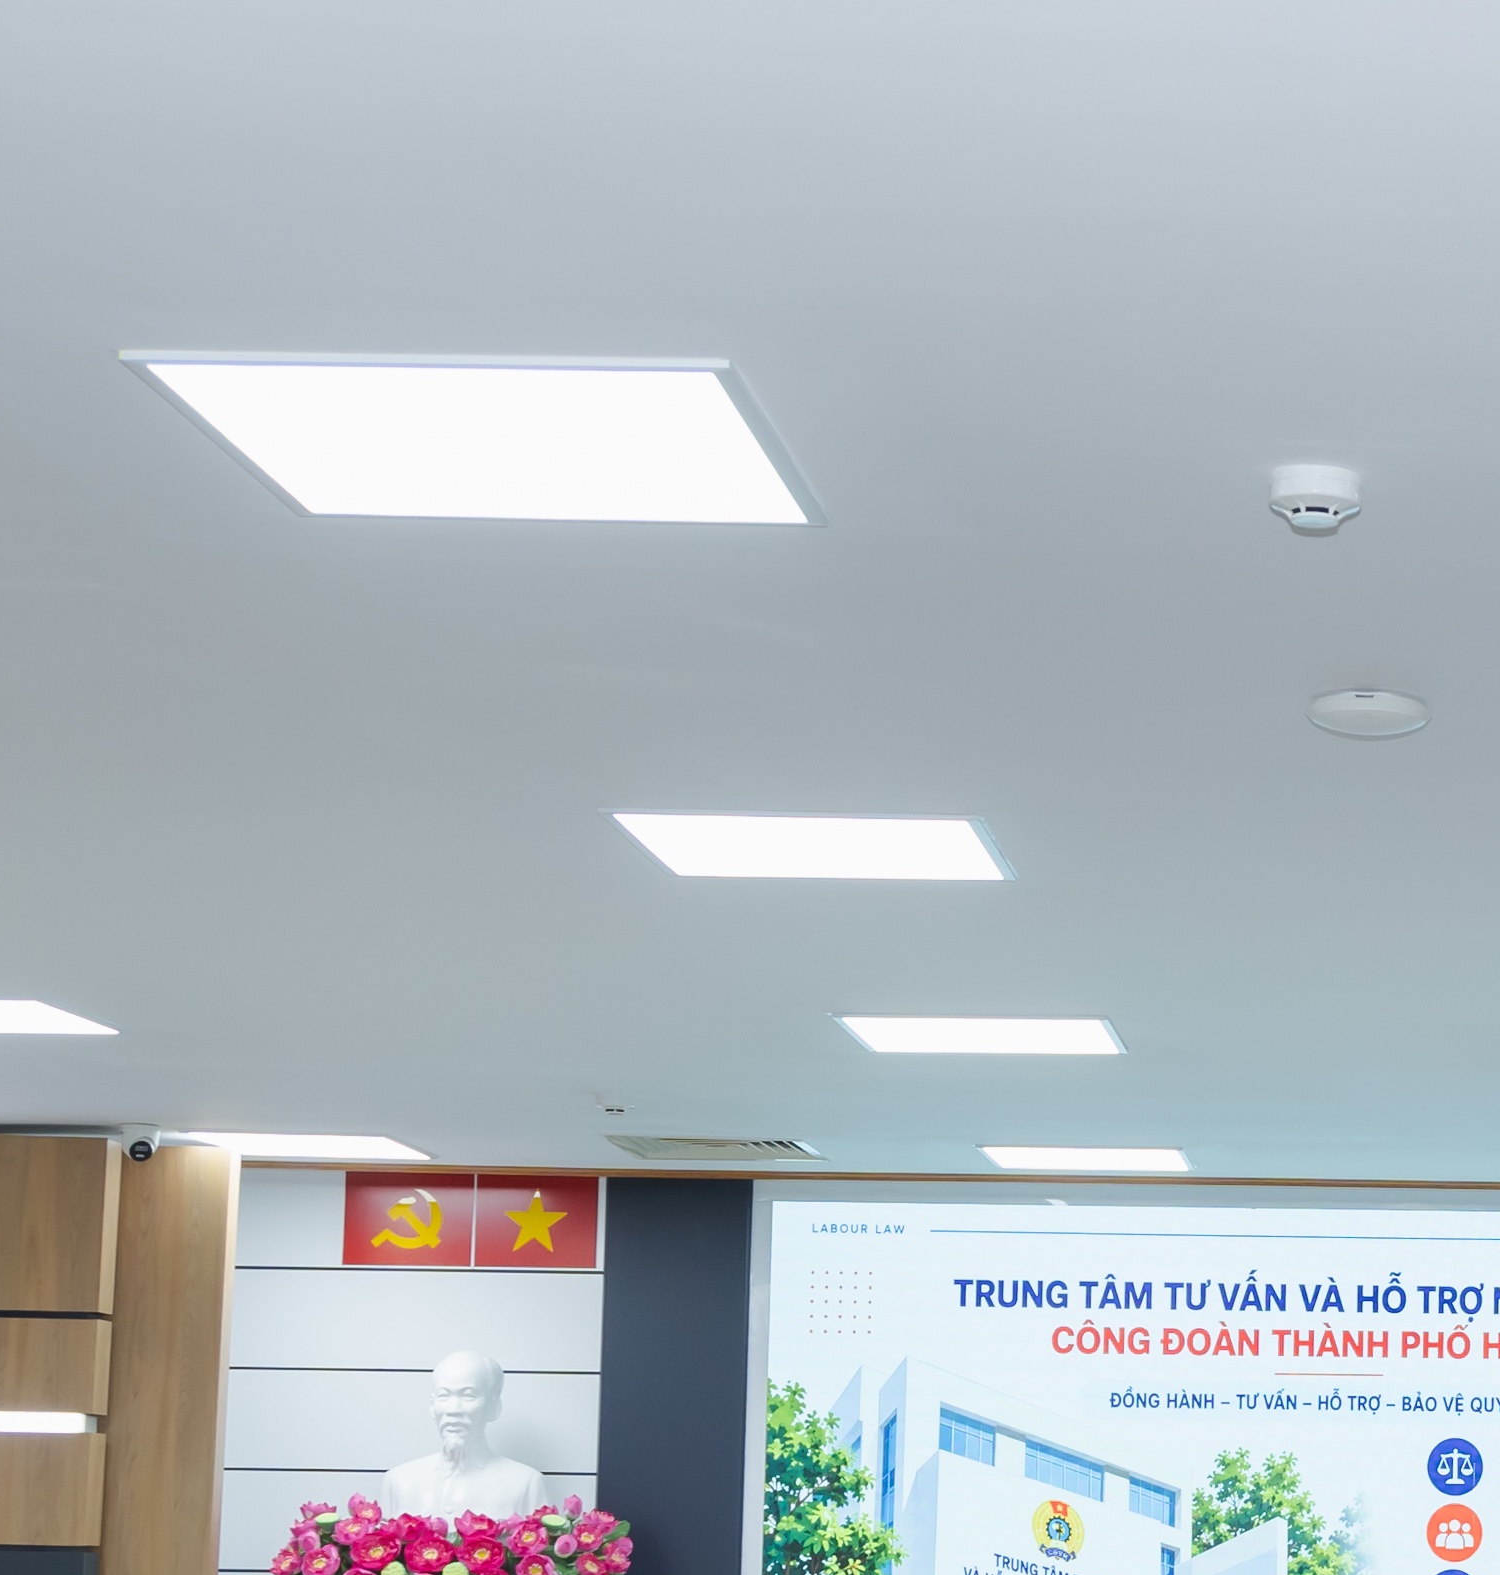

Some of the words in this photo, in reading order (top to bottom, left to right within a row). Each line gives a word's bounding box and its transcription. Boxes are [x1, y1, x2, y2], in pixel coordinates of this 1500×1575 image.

[812, 1223, 868, 1234] LABOUR
[875, 1224, 905, 1234] LAW
[954, 1279, 1068, 1308] TRUNG
[1079, 1274, 1153, 1310] TÂM
[1164, 1280, 1211, 1310] TƯ
[1218, 1269, 1286, 1312] VẤN
[1299, 1277, 1345, 1312] VÀ
[1357, 1272, 1406, 1313] HỖ
[1417, 1283, 1484, 1322] TRỢ
[1052, 1319, 1150, 1354] CÔNG
[1161, 1321, 1260, 1356] ĐOÀN
[1272, 1323, 1388, 1357] THÀNH
[1401, 1324, 1470, 1359] PHỐ
[1110, 1386, 1160, 1408] ĐỒNG
[1167, 1389, 1214, 1409] HÀNH
[1236, 1393, 1260, 1410] TƯ
[1263, 1389, 1297, 1410] VẤN
[1318, 1388, 1342, 1411] HỖ
[1348, 1394, 1381, 1415] TRỢ
[1402, 1391, 1437, 1412] BẢO
[1445, 1395, 1464, 1416] VỆ
